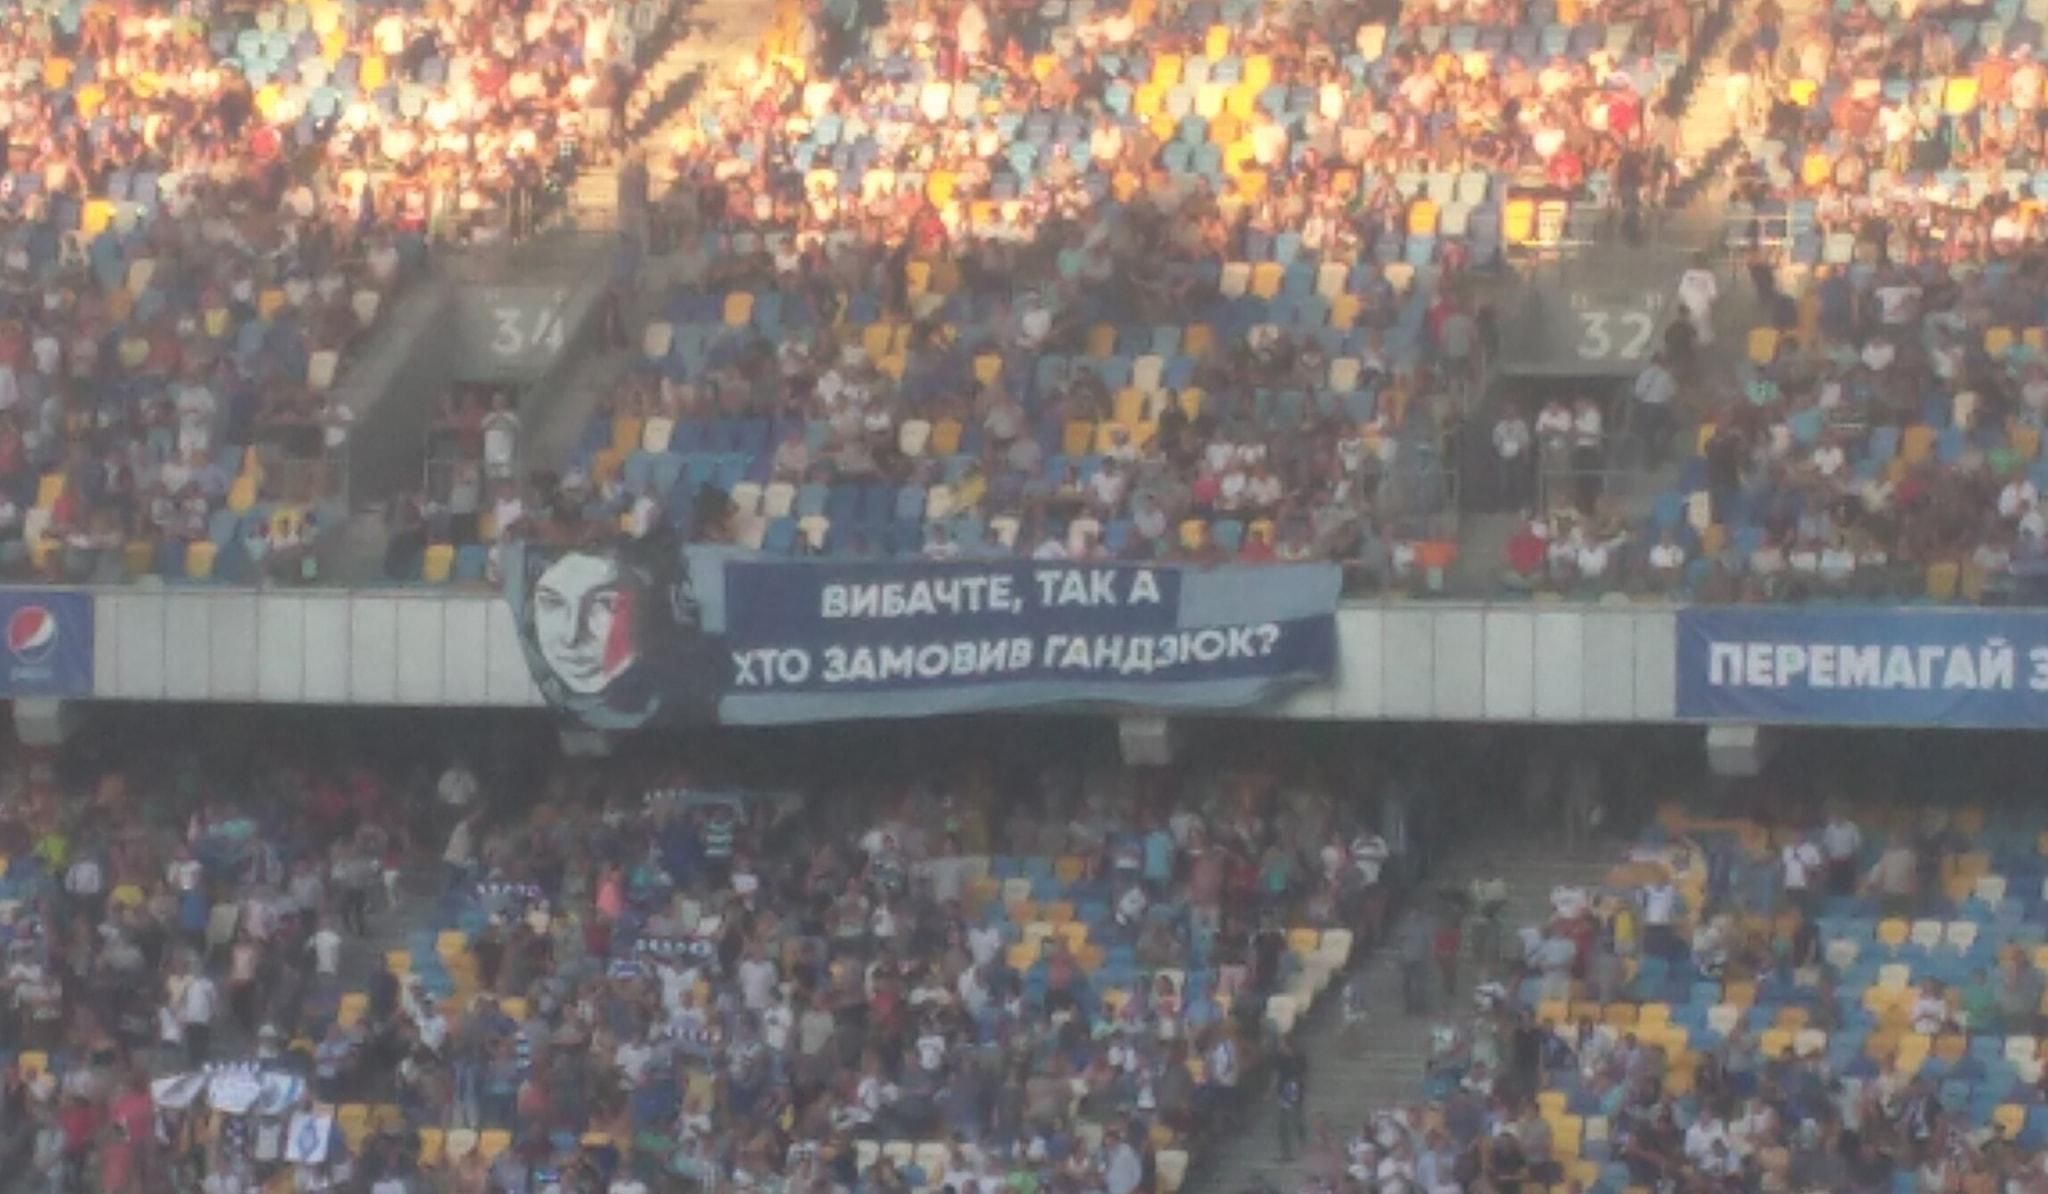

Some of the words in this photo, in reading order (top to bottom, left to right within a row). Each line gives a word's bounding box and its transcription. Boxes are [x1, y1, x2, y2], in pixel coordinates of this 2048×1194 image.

[820, 574, 1022, 618] ВИБАЧТЕ,
[1035, 569, 1116, 606] ТАК
[1129, 570, 1160, 604] А
[732, 647, 809, 686] ХТО
[822, 637, 1031, 682] ЗАМОВИВ
[1044, 624, 1280, 676] ГАНДЗЮК?
[1708, 636, 2014, 690] ПЕРЕМАГАЙ
